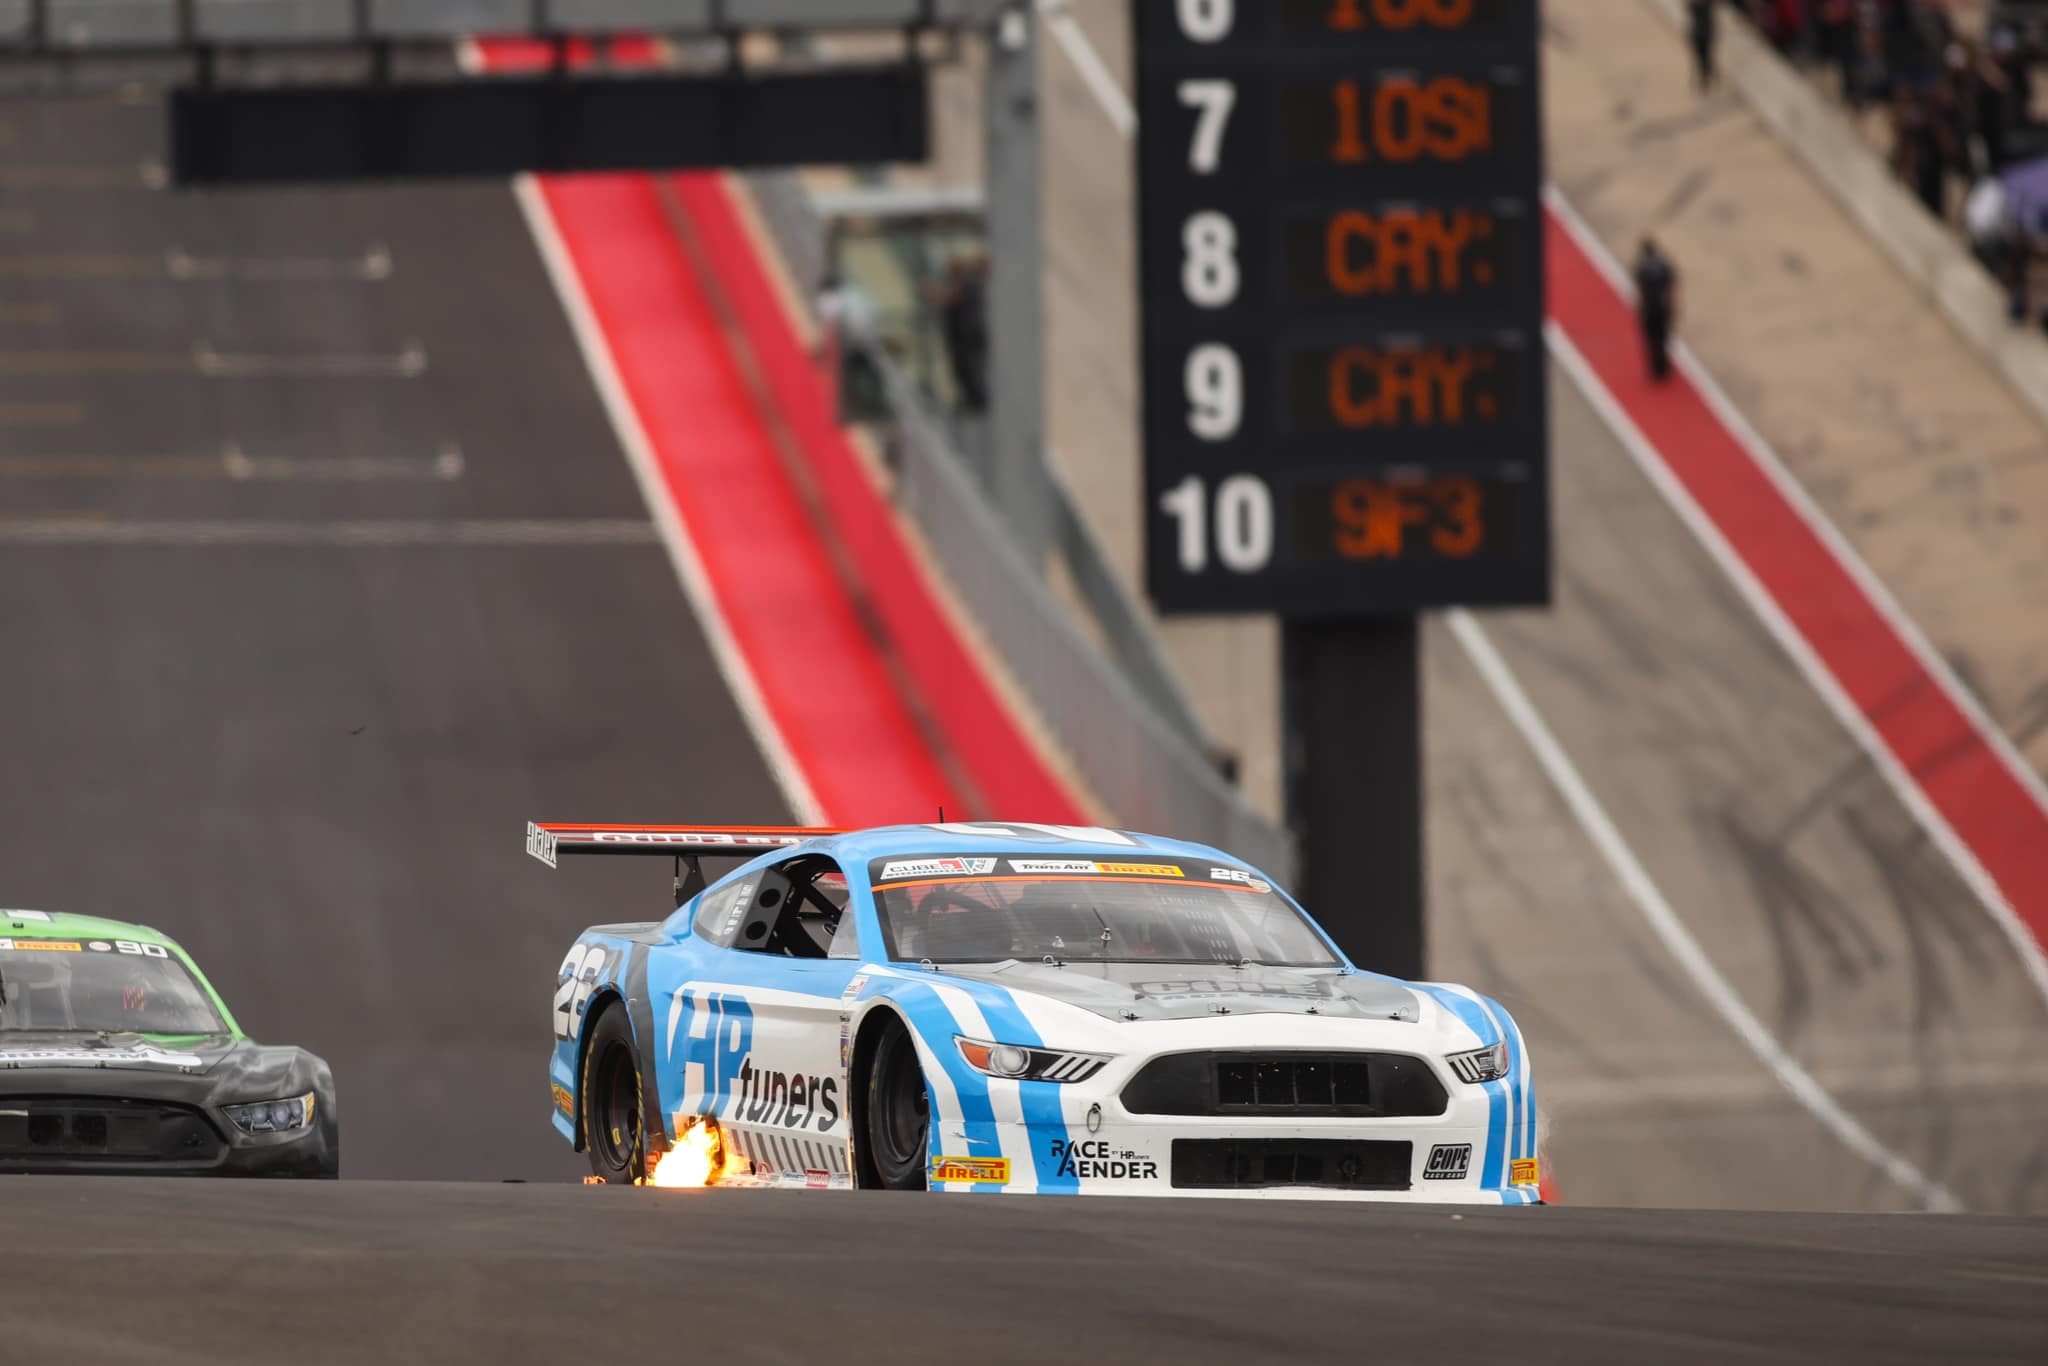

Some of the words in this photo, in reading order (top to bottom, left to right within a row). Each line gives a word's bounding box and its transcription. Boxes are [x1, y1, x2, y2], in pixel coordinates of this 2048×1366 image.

[1177, 79, 1236, 173] 7
[1182, 210, 1239, 307] 8
[1184, 342, 1243, 441] 9
[1160, 474, 1274, 573] 10
[1101, 864, 1177, 875] PIRELLI
[1210, 868, 1250, 881] 26
[115, 941, 168, 958] 90
[554, 944, 606, 1041] 26
[674, 988, 754, 1119] HP
[735, 1058, 839, 1132] tuners
[938, 1161, 1005, 1180] PIRELLI
[1051, 1139, 1110, 1159] RACE
[1063, 1160, 1159, 1179] RENDER
[1429, 1147, 1470, 1170] COPE
